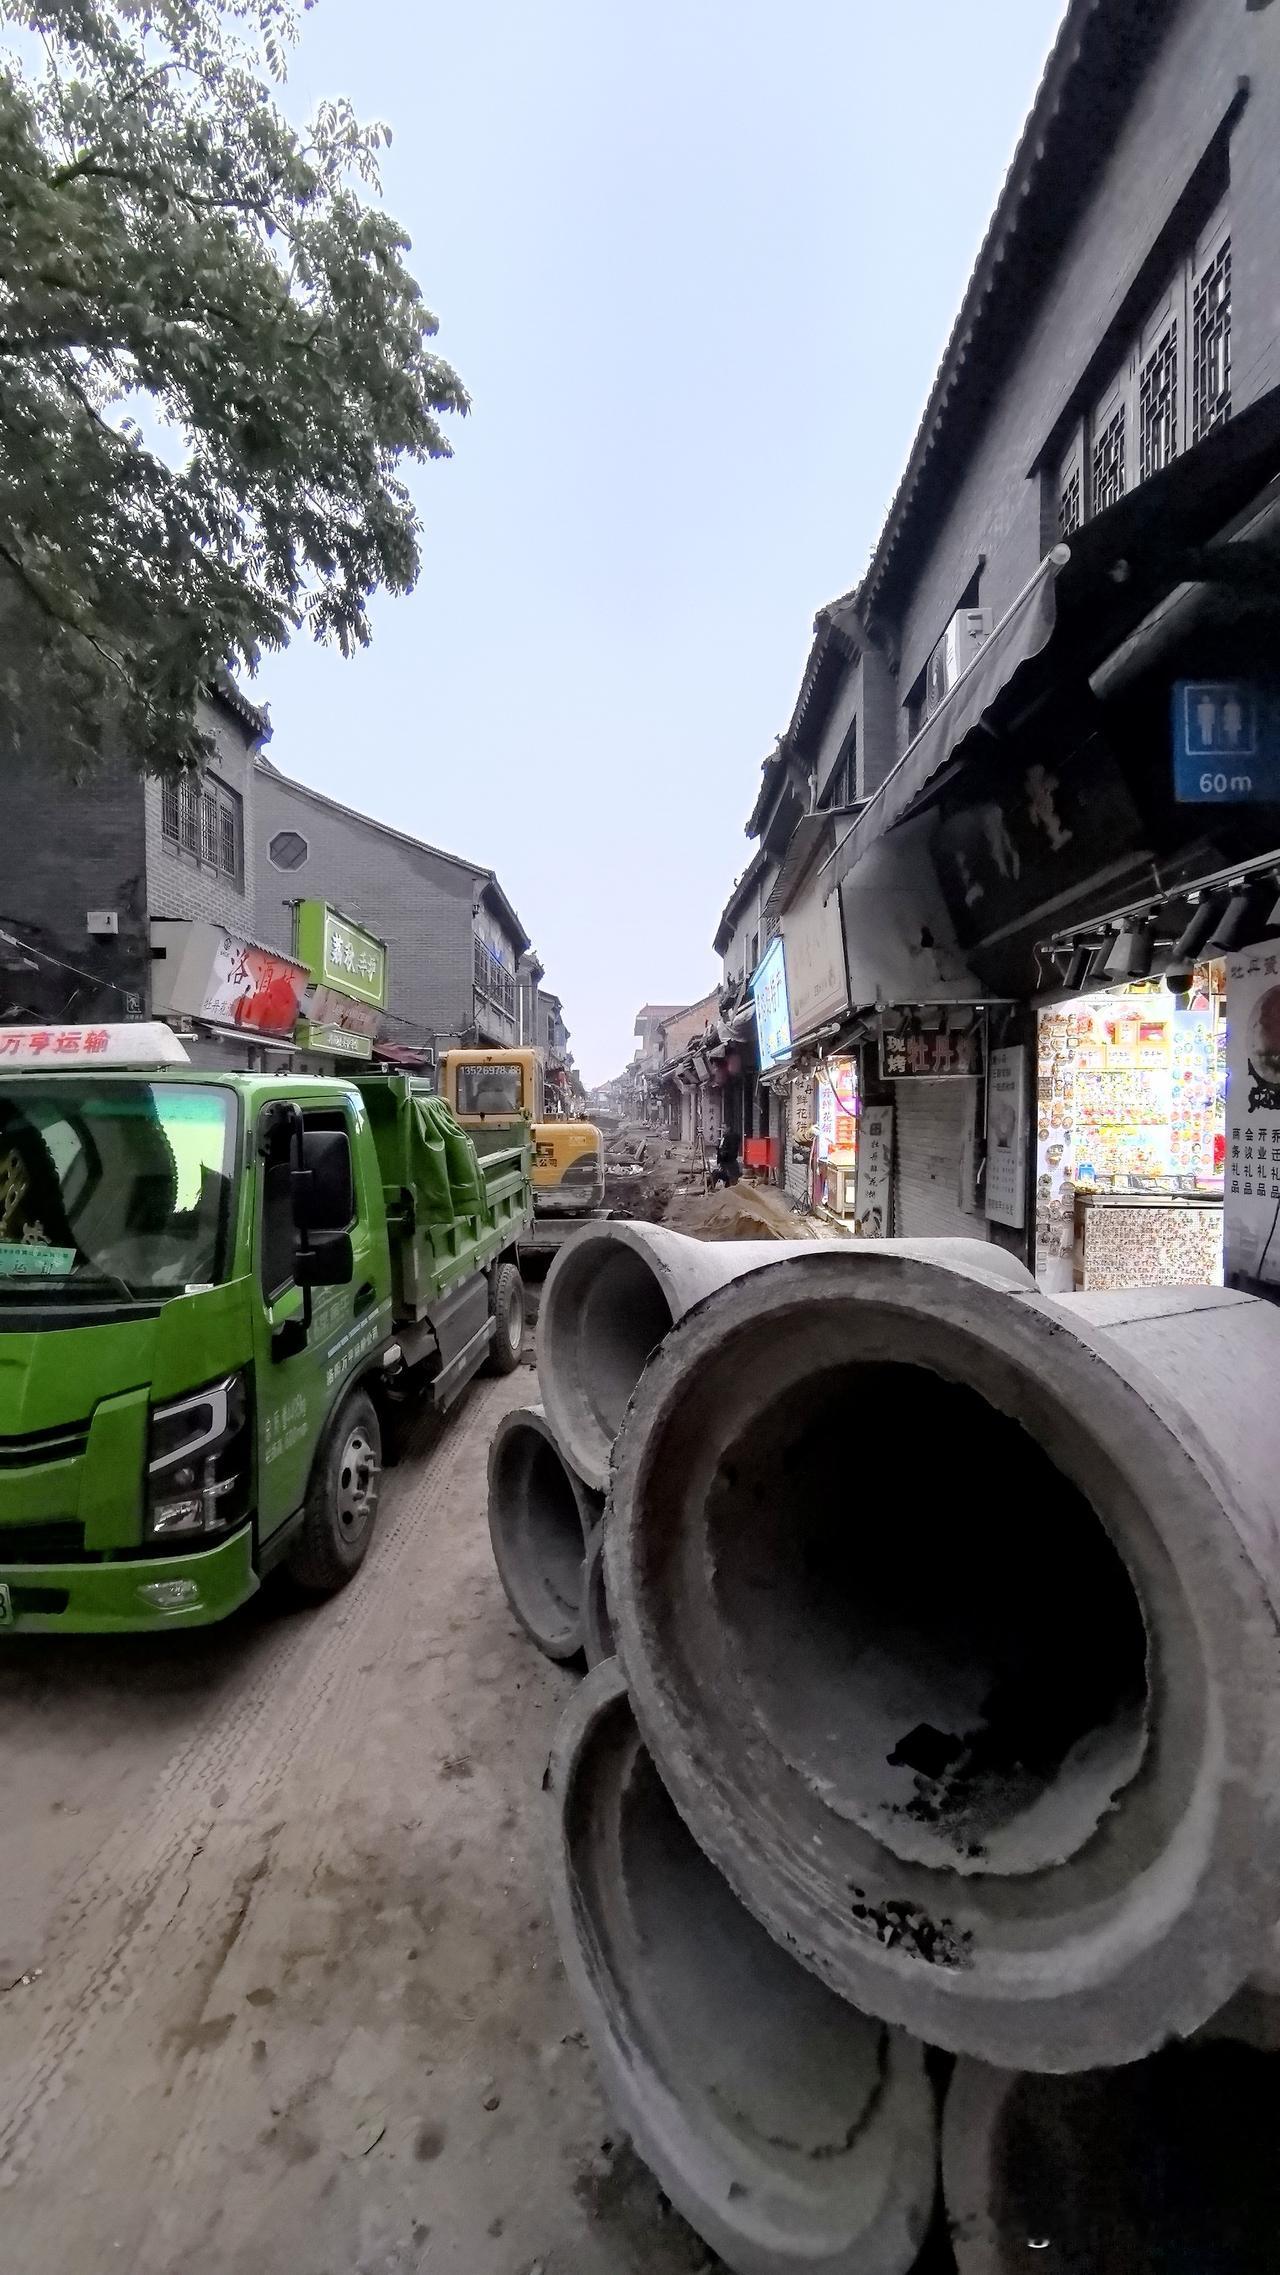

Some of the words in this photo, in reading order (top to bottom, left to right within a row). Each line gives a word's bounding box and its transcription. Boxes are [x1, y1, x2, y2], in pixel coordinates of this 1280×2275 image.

[1200, 773, 1252, 793] 60m
[1231, 1128, 1241, 1194] 商务礼品
[1244, 1128, 1254, 1195] 会议礼品
[1257, 1128, 1268, 1197] 开业礼品
